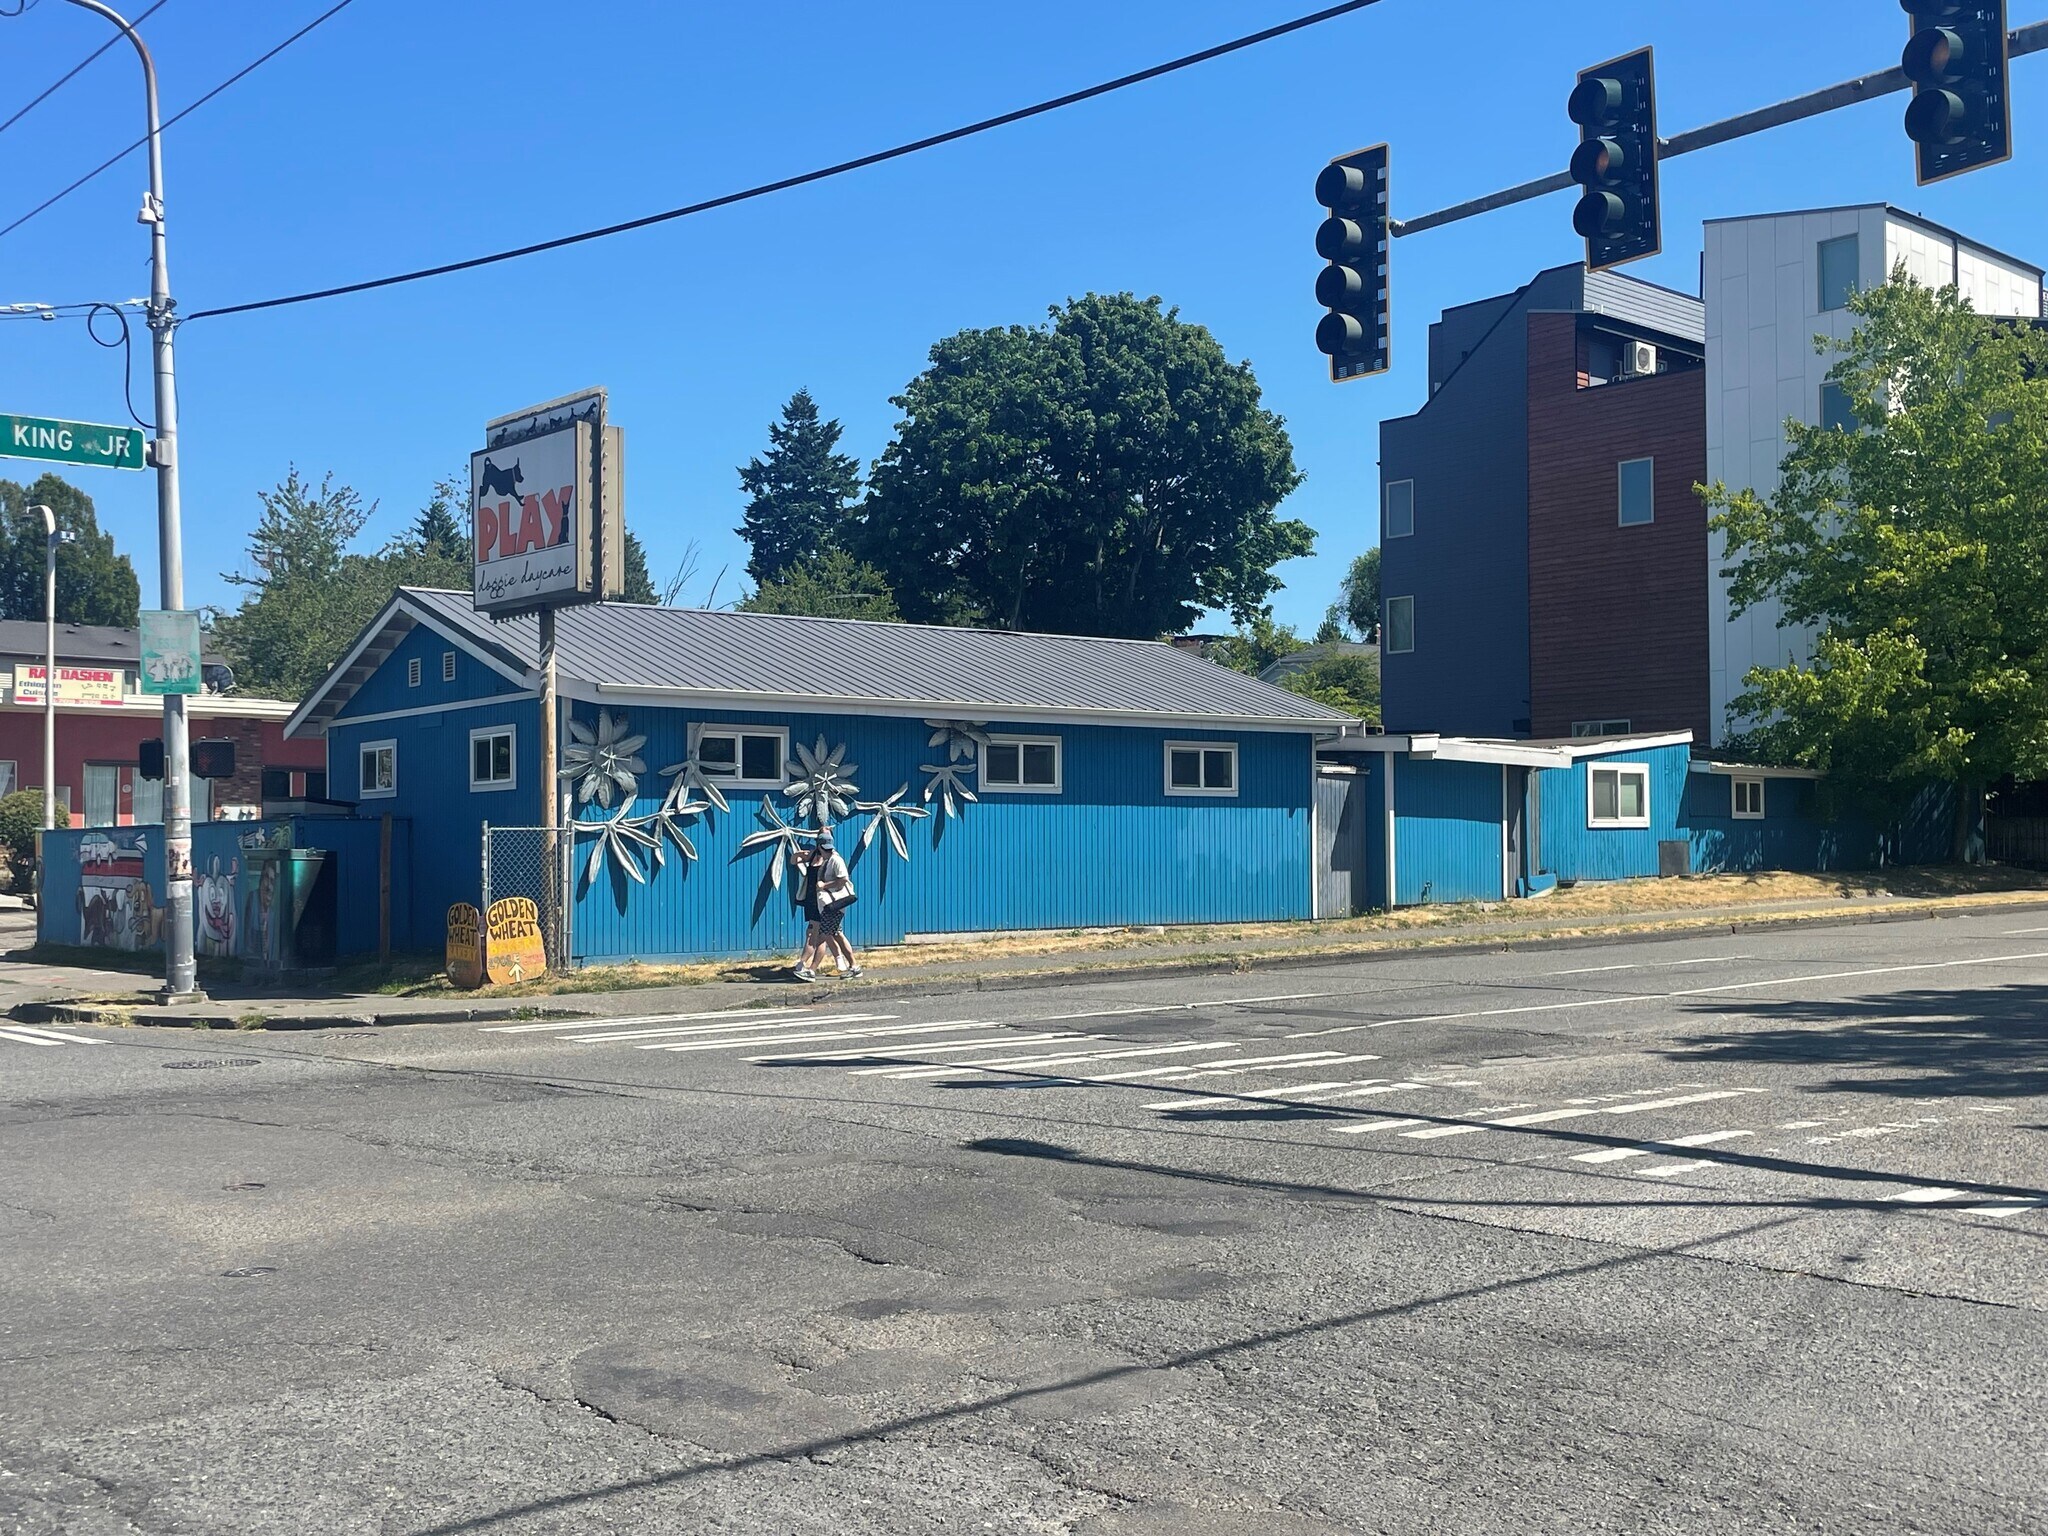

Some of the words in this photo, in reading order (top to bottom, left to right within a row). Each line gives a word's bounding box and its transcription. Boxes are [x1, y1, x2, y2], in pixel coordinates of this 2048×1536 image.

[14, 425, 73, 452] KING
[101, 435, 130, 458] JR
[478, 485, 574, 563] PLAY
[478, 568, 517, 599] doggie
[521, 561, 573, 591] daycare
[61, 670, 114, 682] DASHEN
[449, 905, 477, 927] GOLDEN
[488, 899, 535, 928] GOLDEN
[449, 927, 477, 946] WHEAT
[489, 921, 535, 941] WHEAT
